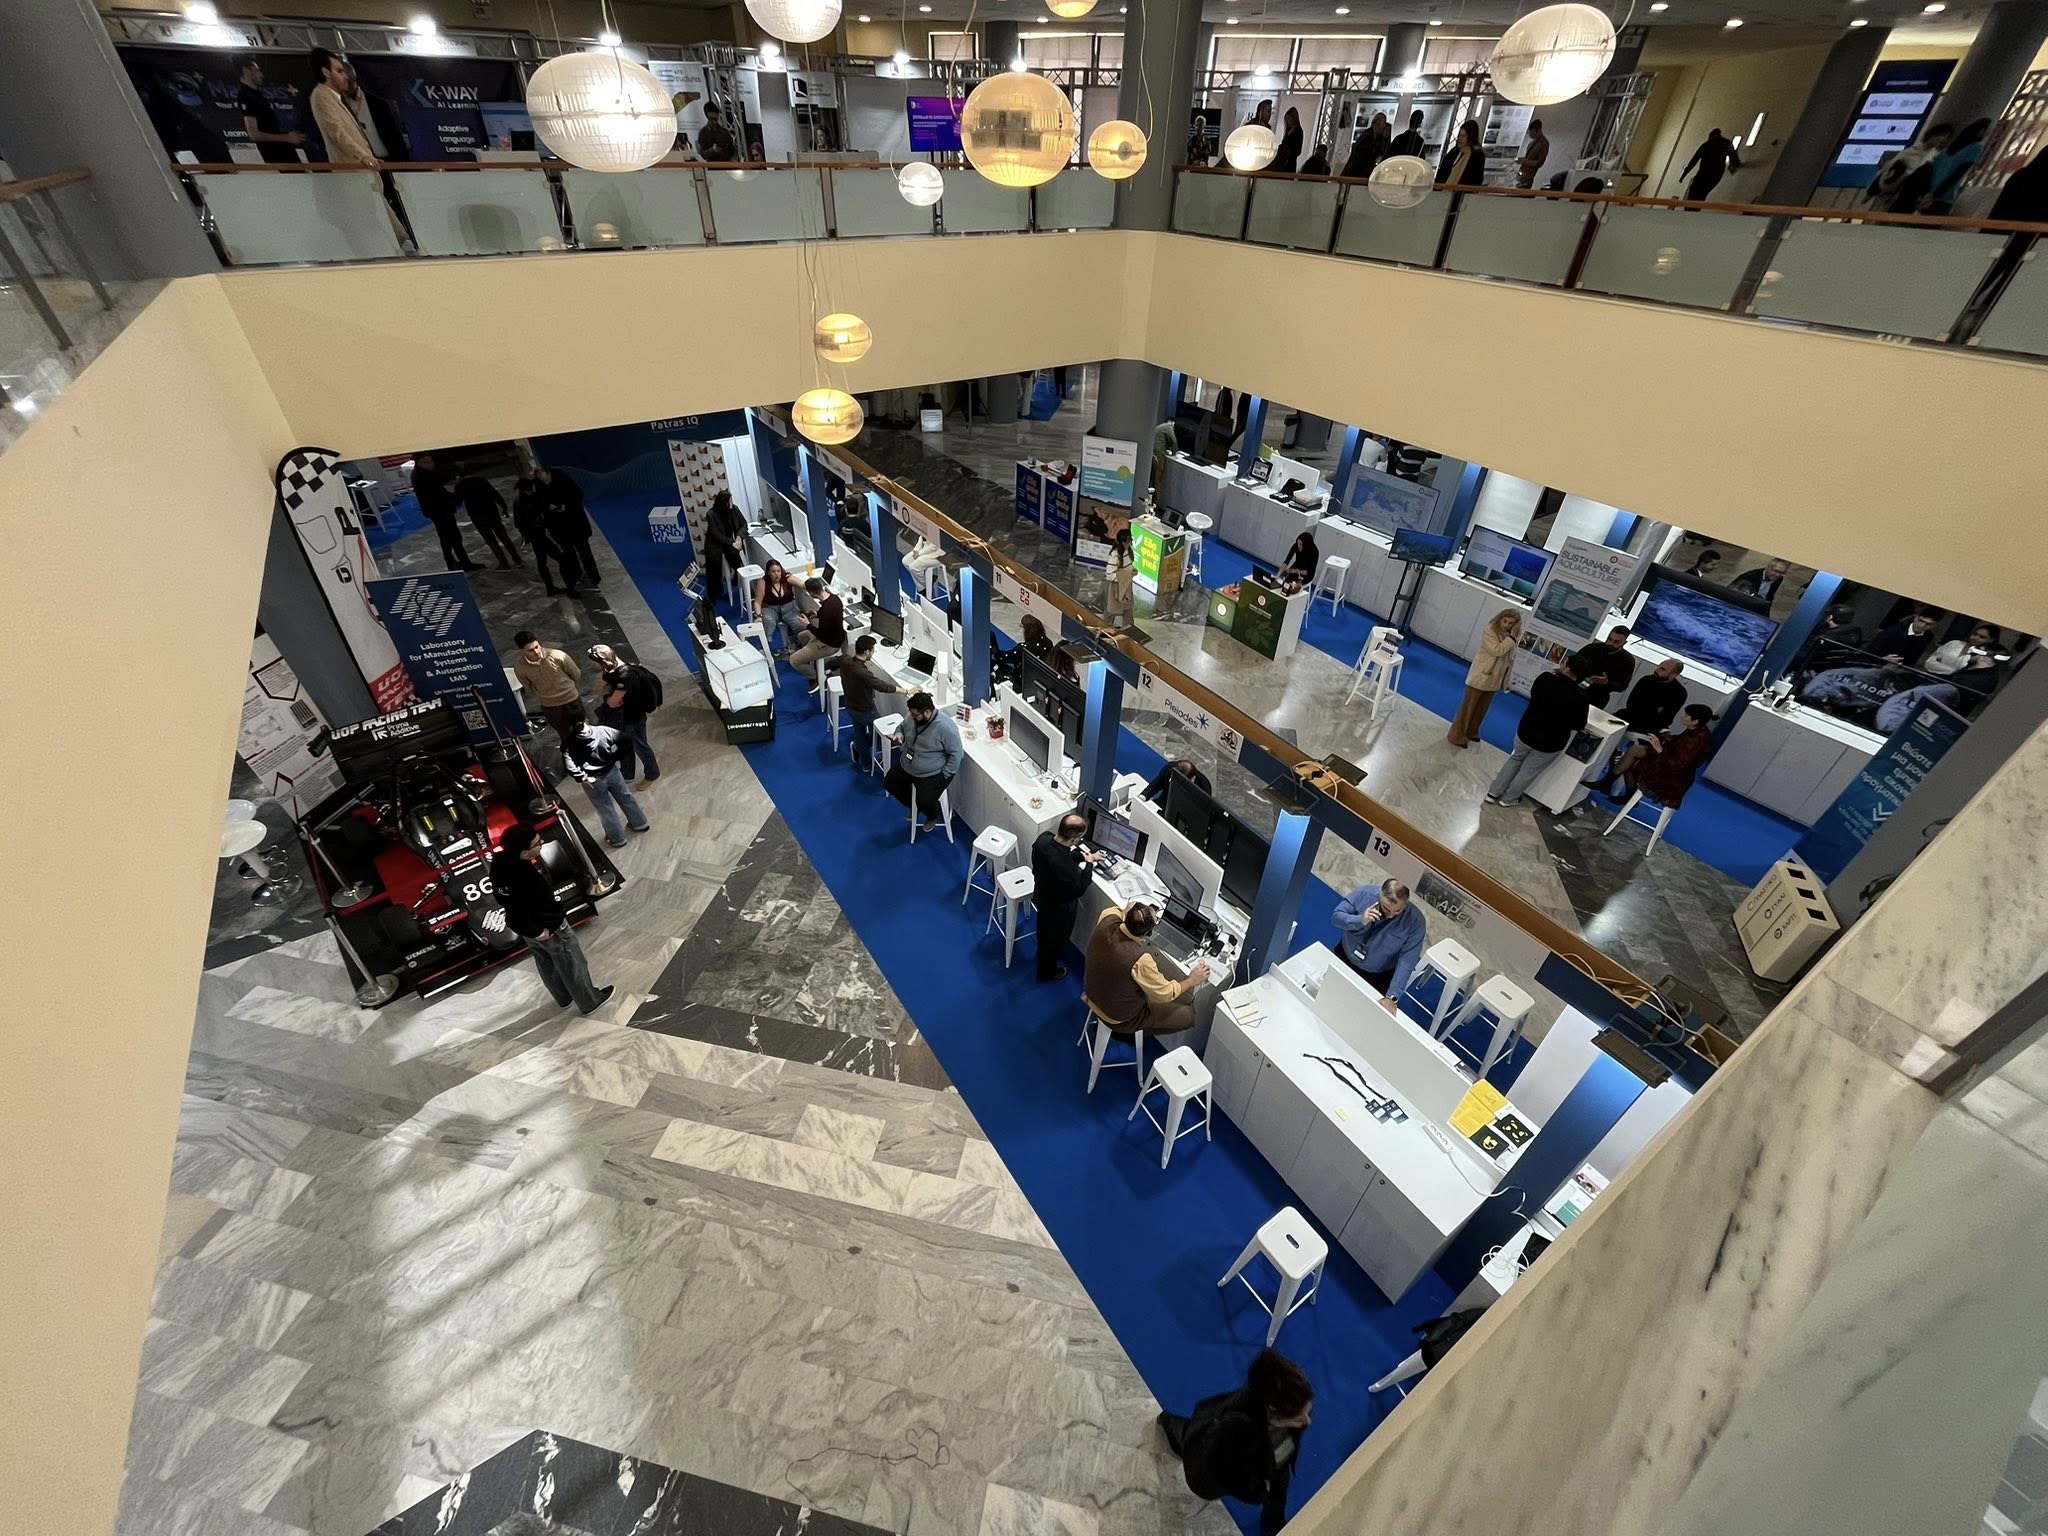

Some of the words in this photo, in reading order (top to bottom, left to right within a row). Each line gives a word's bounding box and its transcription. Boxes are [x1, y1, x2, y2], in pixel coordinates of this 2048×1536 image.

[425, 85, 478, 100] K-WAY
[651, 420, 684, 430] Patras
[687, 416, 699, 426] IQ
[1561, 550, 1620, 577] SUSTAINABLE
[1558, 559, 1621, 587] AQUACULTURE
[420, 639, 465, 651] Laboratory
[409, 654, 422, 662] for
[424, 645, 485, 660] Manufacturing
[433, 656, 468, 668] Systems
[435, 663, 483, 676] Automation
[449, 674, 468, 683] LMS
[1142, 673, 1152, 689] 12
[331, 723, 360, 740] UOP
[362, 708, 408, 731] RACING
[409, 697, 442, 716] TEAM
[1164, 698, 1199, 730] Pleiades
[387, 721, 410, 732] Prima
[391, 724, 420, 738] Additive
[1890, 751, 1908, 766] μια
[1901, 741, 1933, 769] Βιώστε
[1373, 837, 1391, 857] 13
[463, 876, 494, 901] 86
[405, 944, 436, 960] SIEMENS
